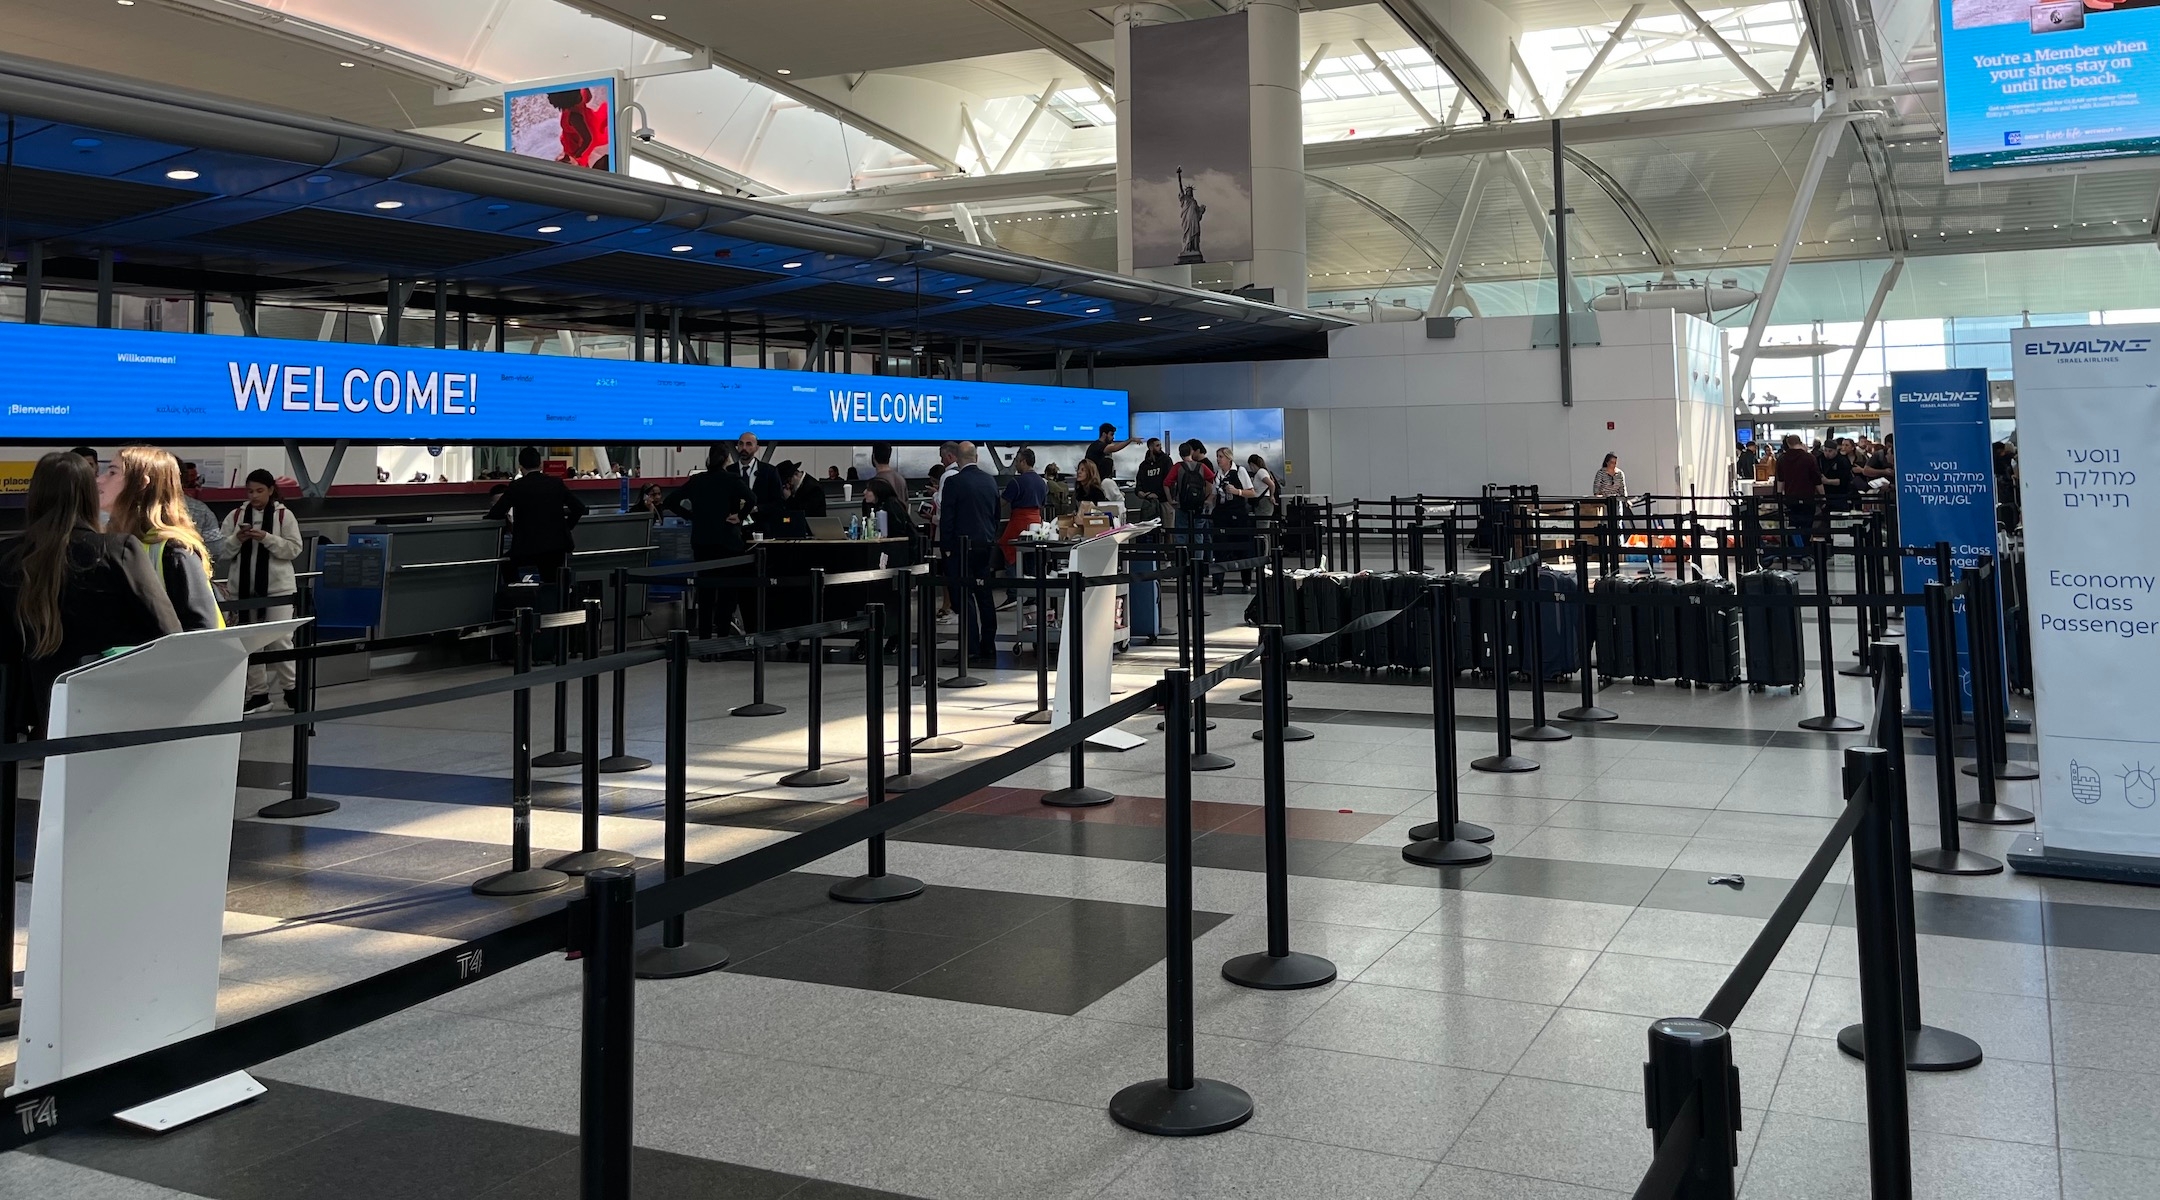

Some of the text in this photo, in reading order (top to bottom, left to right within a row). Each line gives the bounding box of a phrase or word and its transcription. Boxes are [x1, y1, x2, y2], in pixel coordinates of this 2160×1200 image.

[1973, 41, 2147, 68] You're a Member when
[1990, 57, 2132, 84] your shoes stay on
[2002, 72, 2121, 94] until the beach.
[2045, 130, 2064, 140] live
[117, 353, 176, 364] Willkommen!
[228, 362, 478, 416] WELCOME!
[8, 404, 70, 416] ¡Bienvenido!
[829, 389, 944, 424] WELCOME!
[2067, 449, 2120, 463] נוסעי
[1147, 467, 1161, 477] 1977
[1930, 461, 1957, 470] נוסעי
[1905, 472, 1984, 483] מחלקת עסקים
[2055, 469, 2136, 489] מחלקת
[1904, 484, 1987, 495] ולקוחות היוקרה
[1920, 494, 1972, 505] TP/PL/GL
[2063, 493, 2130, 508] תיירים
[1960, 544, 1991, 555] Class
[2050, 570, 2155, 593] Economy
[1554, 592, 1566, 602] T4
[1689, 595, 1701, 605] T4
[1830, 596, 1843, 604] T4
[2073, 593, 2133, 611] Class
[457, 948, 483, 979] T4
[15, 1096, 59, 1135] T4
